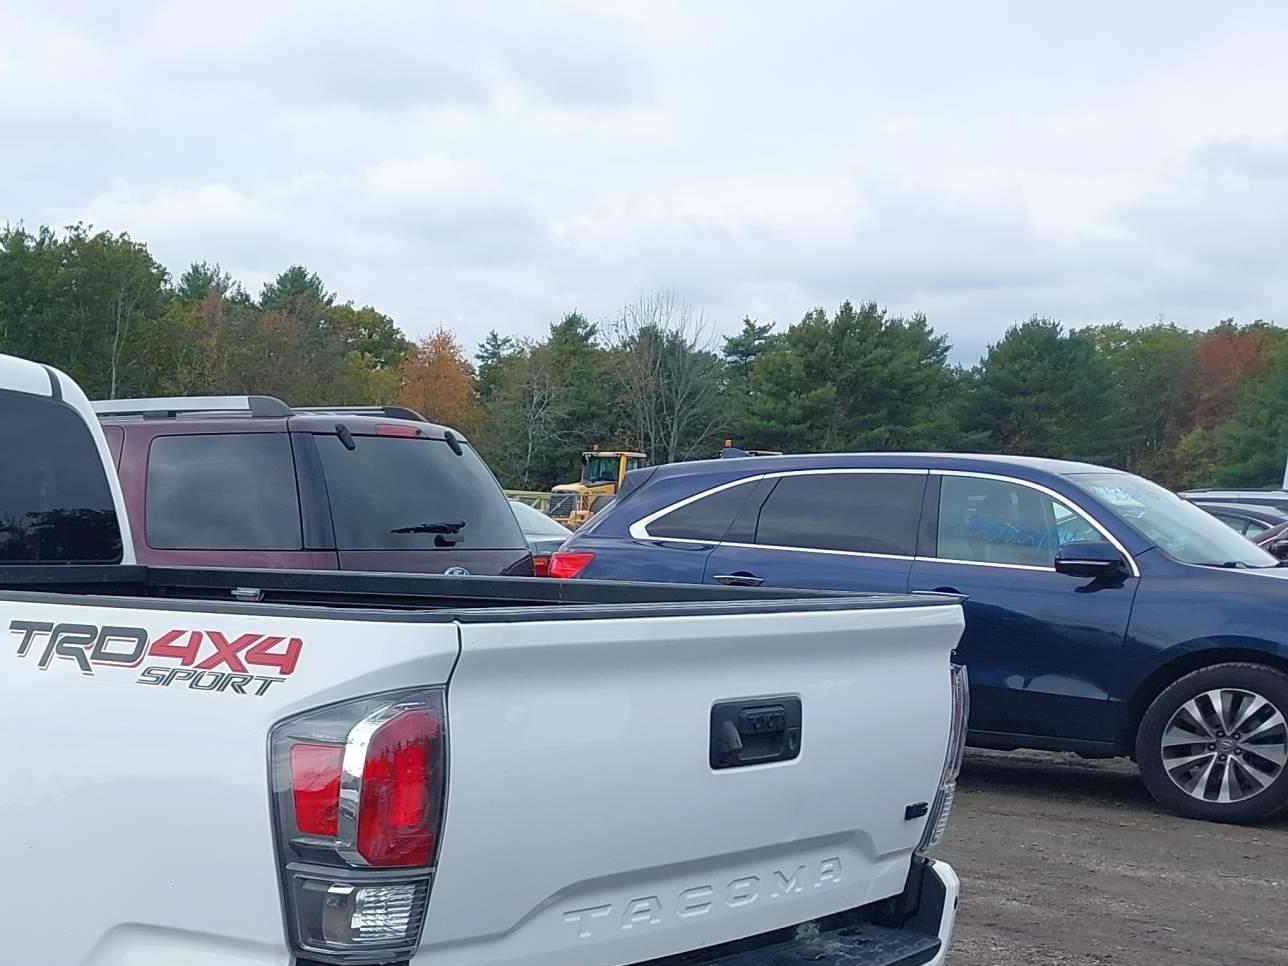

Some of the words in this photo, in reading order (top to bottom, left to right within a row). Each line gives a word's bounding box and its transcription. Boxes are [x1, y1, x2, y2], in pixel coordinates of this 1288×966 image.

[9, 620, 149, 676] TRD
[136, 665, 286, 697] SPORT
[562, 856, 843, 939] TACOMA
